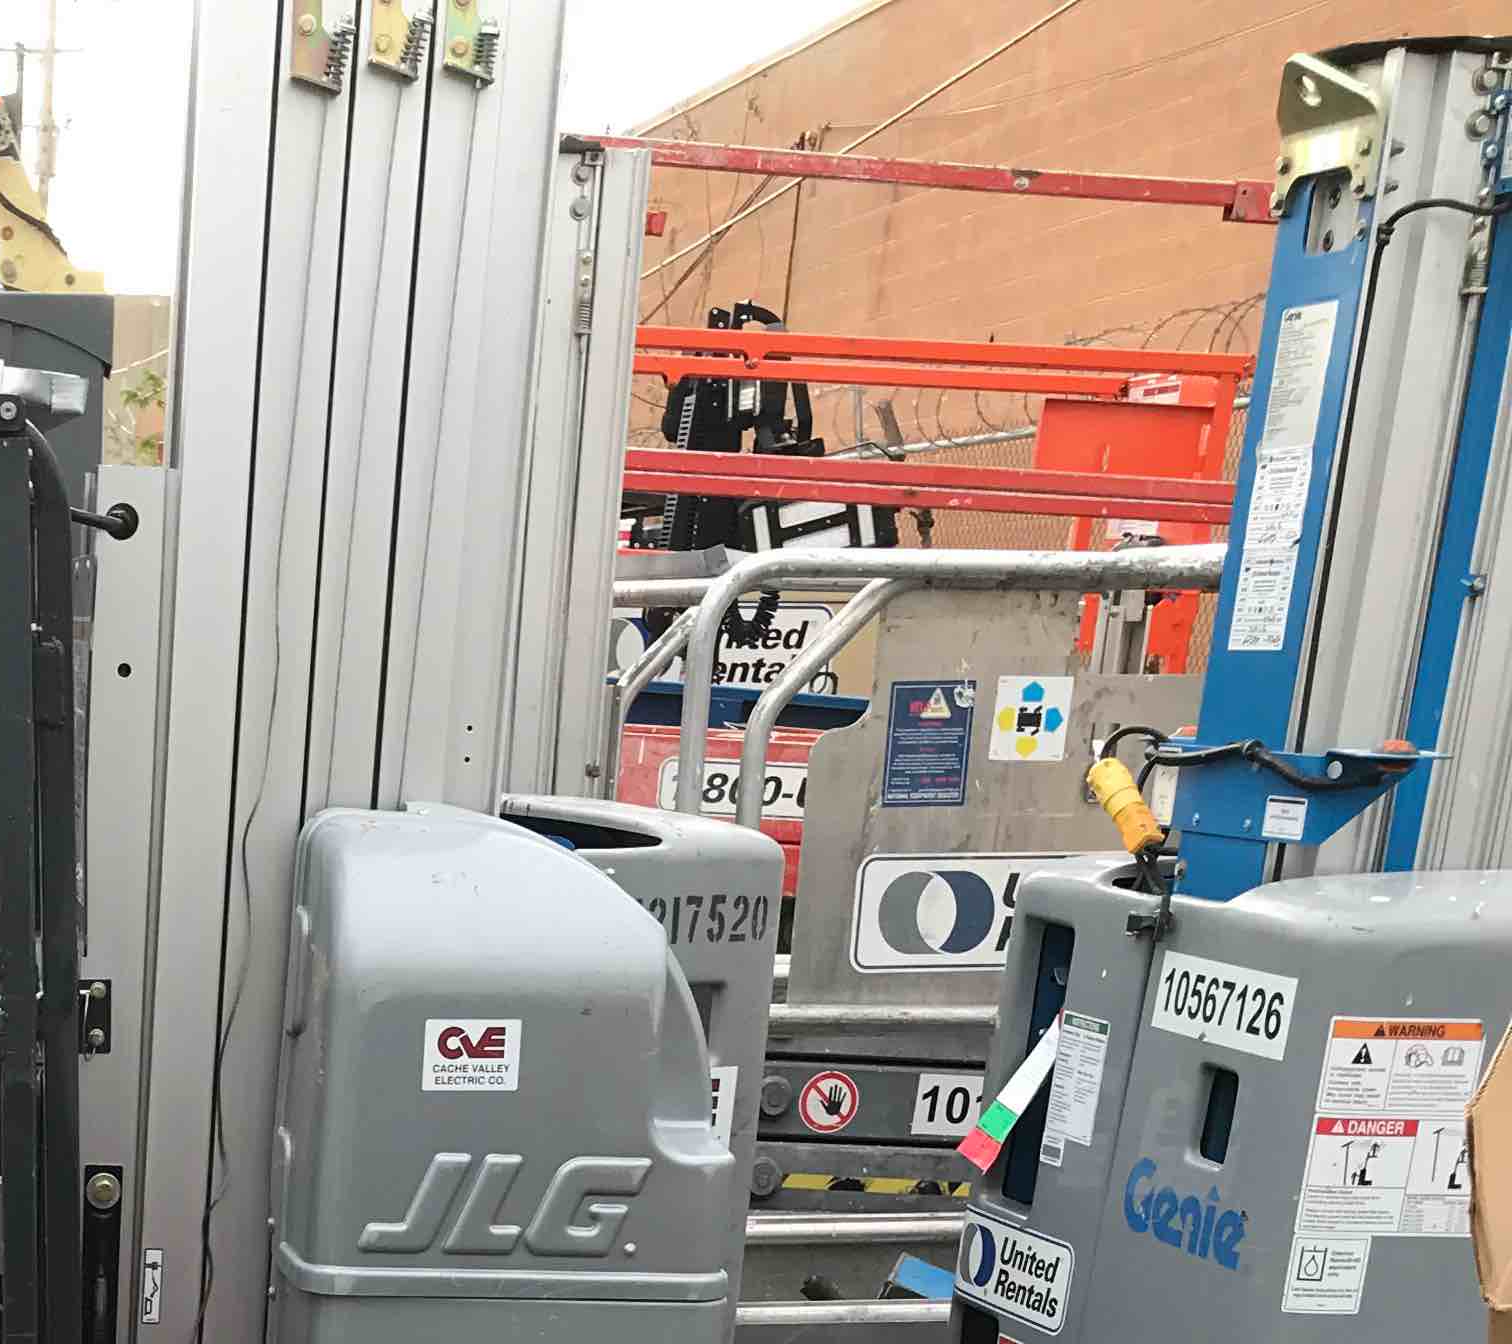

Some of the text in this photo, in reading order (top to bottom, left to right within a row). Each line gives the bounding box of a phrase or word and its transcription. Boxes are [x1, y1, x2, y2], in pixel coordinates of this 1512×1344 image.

[1164, 967, 1285, 1040] 10567126
[1388, 1023, 1446, 1039] WARNING
[433, 1064, 511, 1073] CACHE VALLEY
[434, 1076, 486, 1086] ELECTRIC
[922, 1085, 984, 1124] 10
[1346, 1120, 1406, 1136] DANGER
[1124, 1157, 1249, 1271] Genie
[999, 1236, 1061, 1285] United
[993, 1268, 1059, 1318] Rentals
